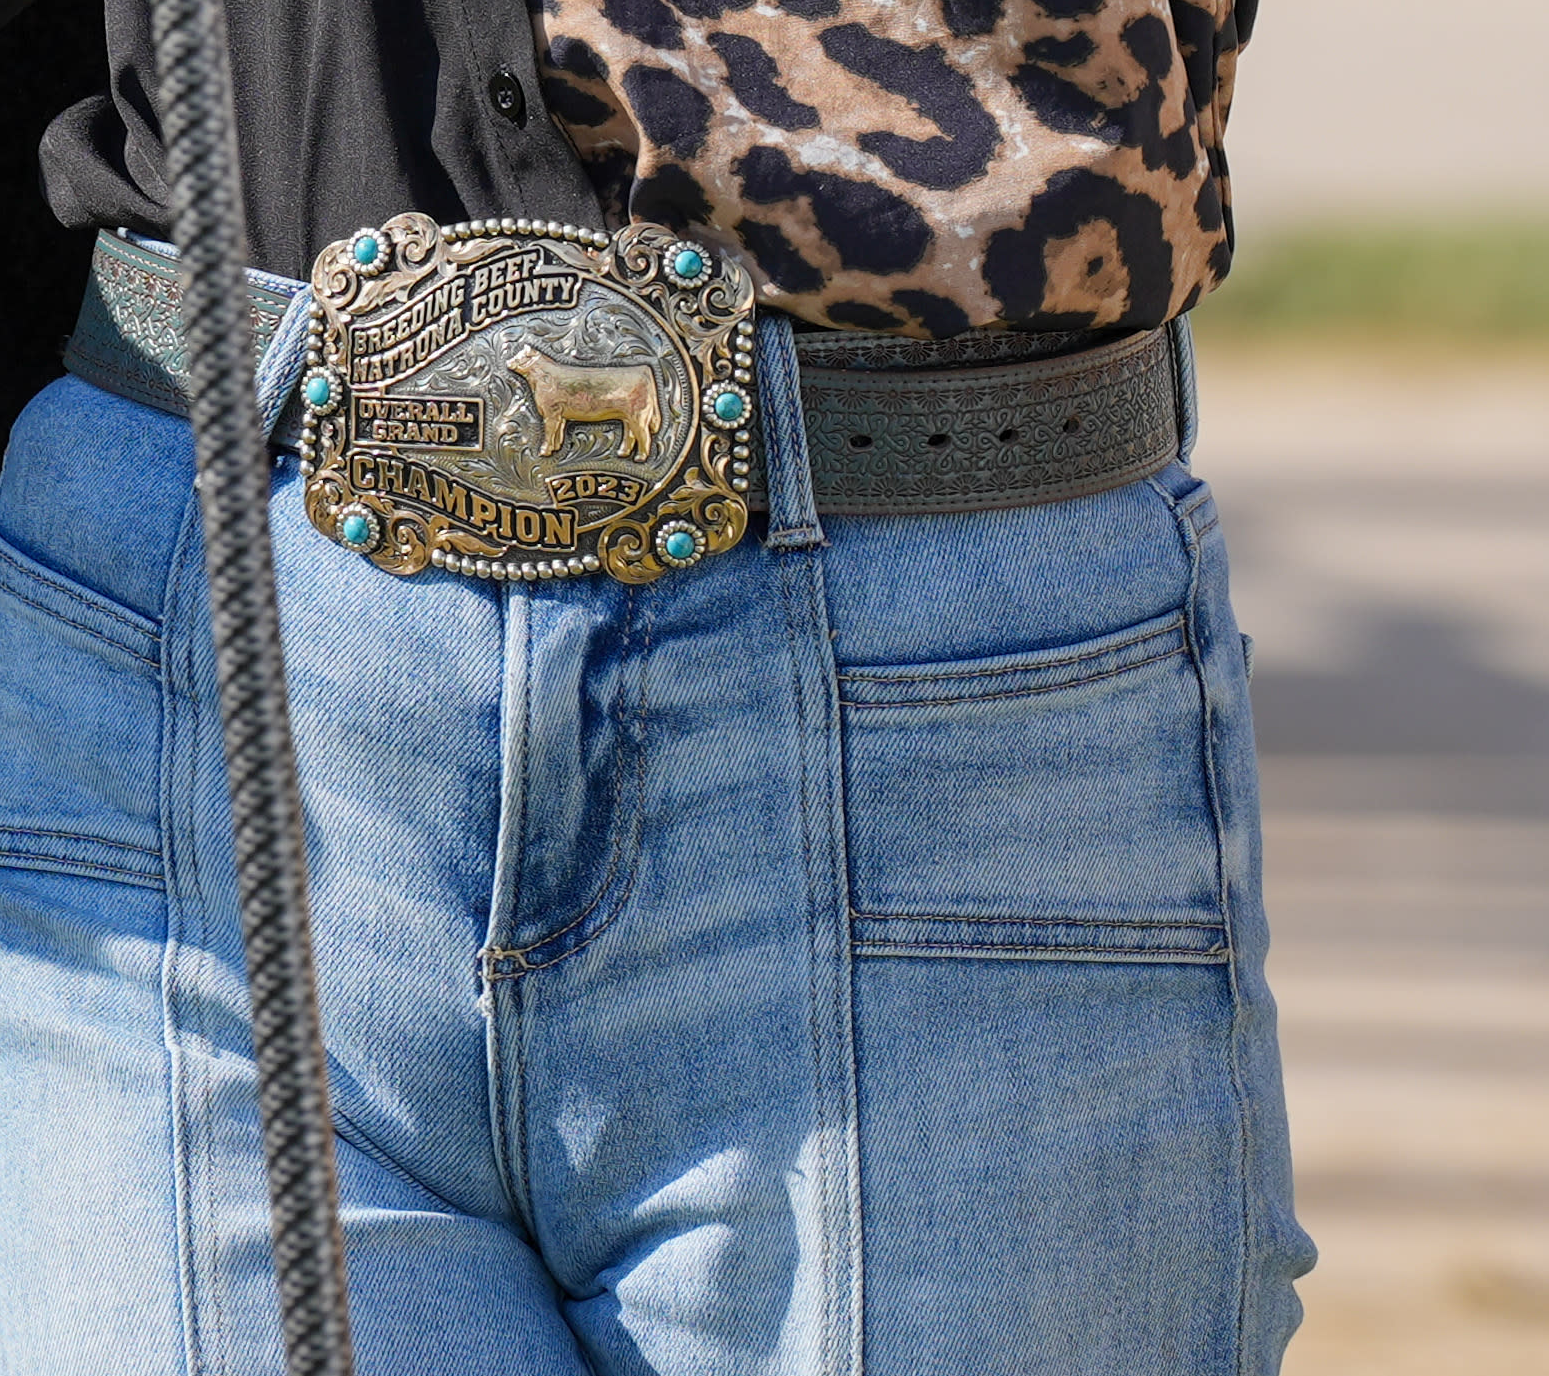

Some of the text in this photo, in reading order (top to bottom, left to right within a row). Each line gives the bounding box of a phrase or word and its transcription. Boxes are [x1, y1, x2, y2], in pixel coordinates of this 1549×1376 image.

[352, 276, 576, 383] NATRONA COUNTY
[353, 253, 539, 356] BREEDING BEEF
[359, 399, 474, 424] OVERALL
[371, 420, 459, 444] GRAND
[353, 454, 574, 546] CHAMPION
[554, 475, 641, 502] 2023
